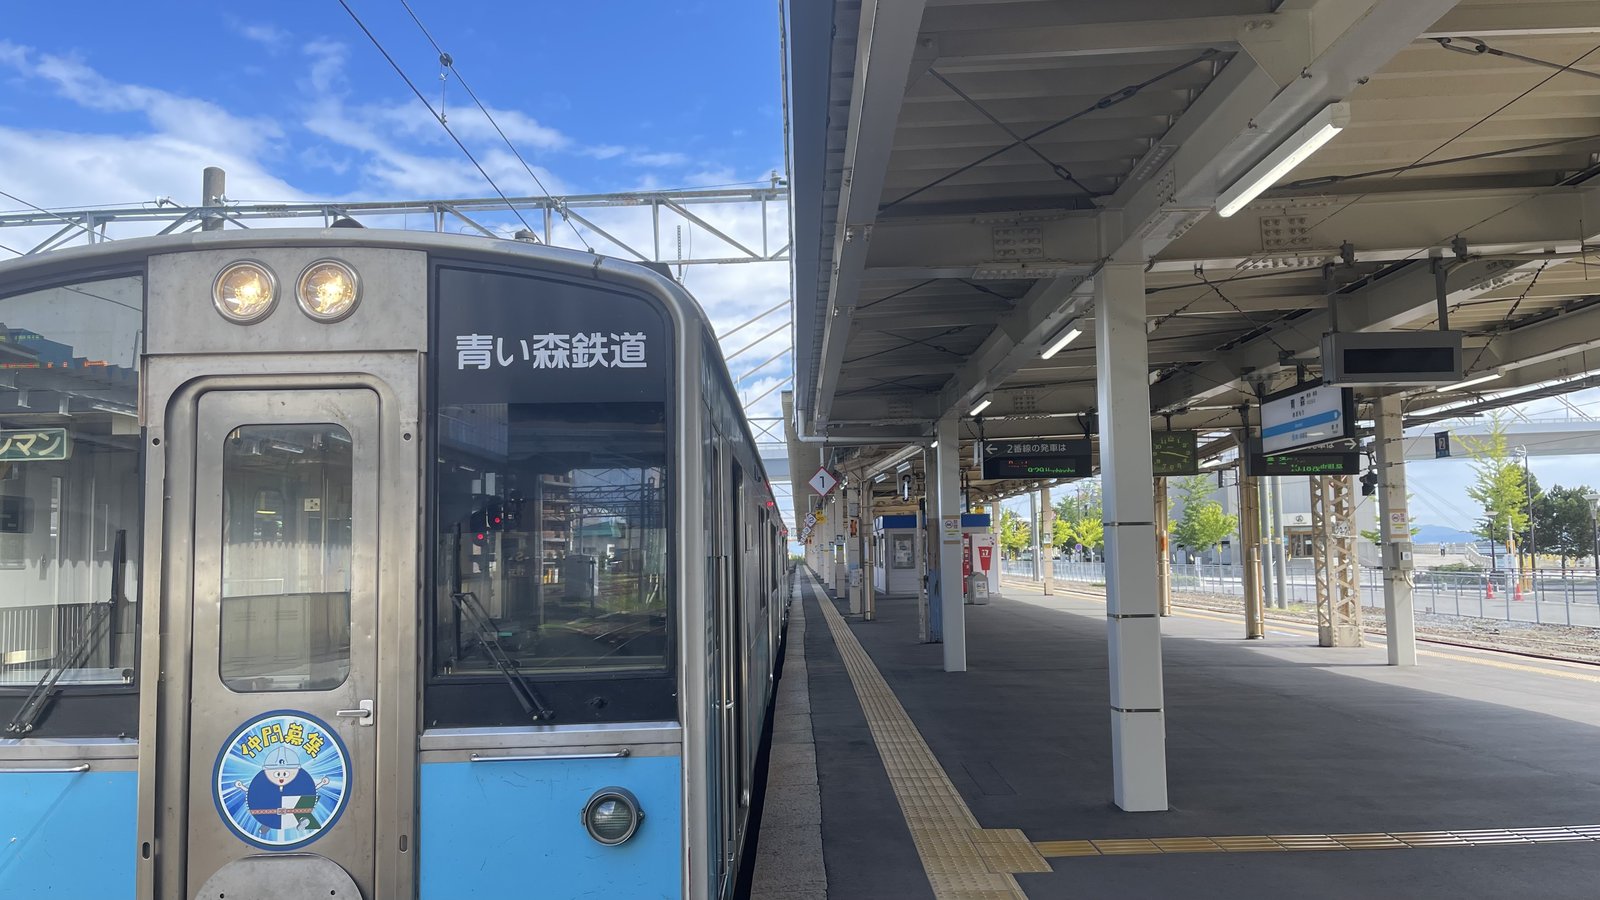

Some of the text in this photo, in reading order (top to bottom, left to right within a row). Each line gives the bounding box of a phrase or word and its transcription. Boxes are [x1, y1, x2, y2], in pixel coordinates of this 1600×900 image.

[456, 332, 647, 369] 青い森鉄道
[1007, 443, 1067, 454] 2番線の発車は
[820, 476, 825, 488] 1
